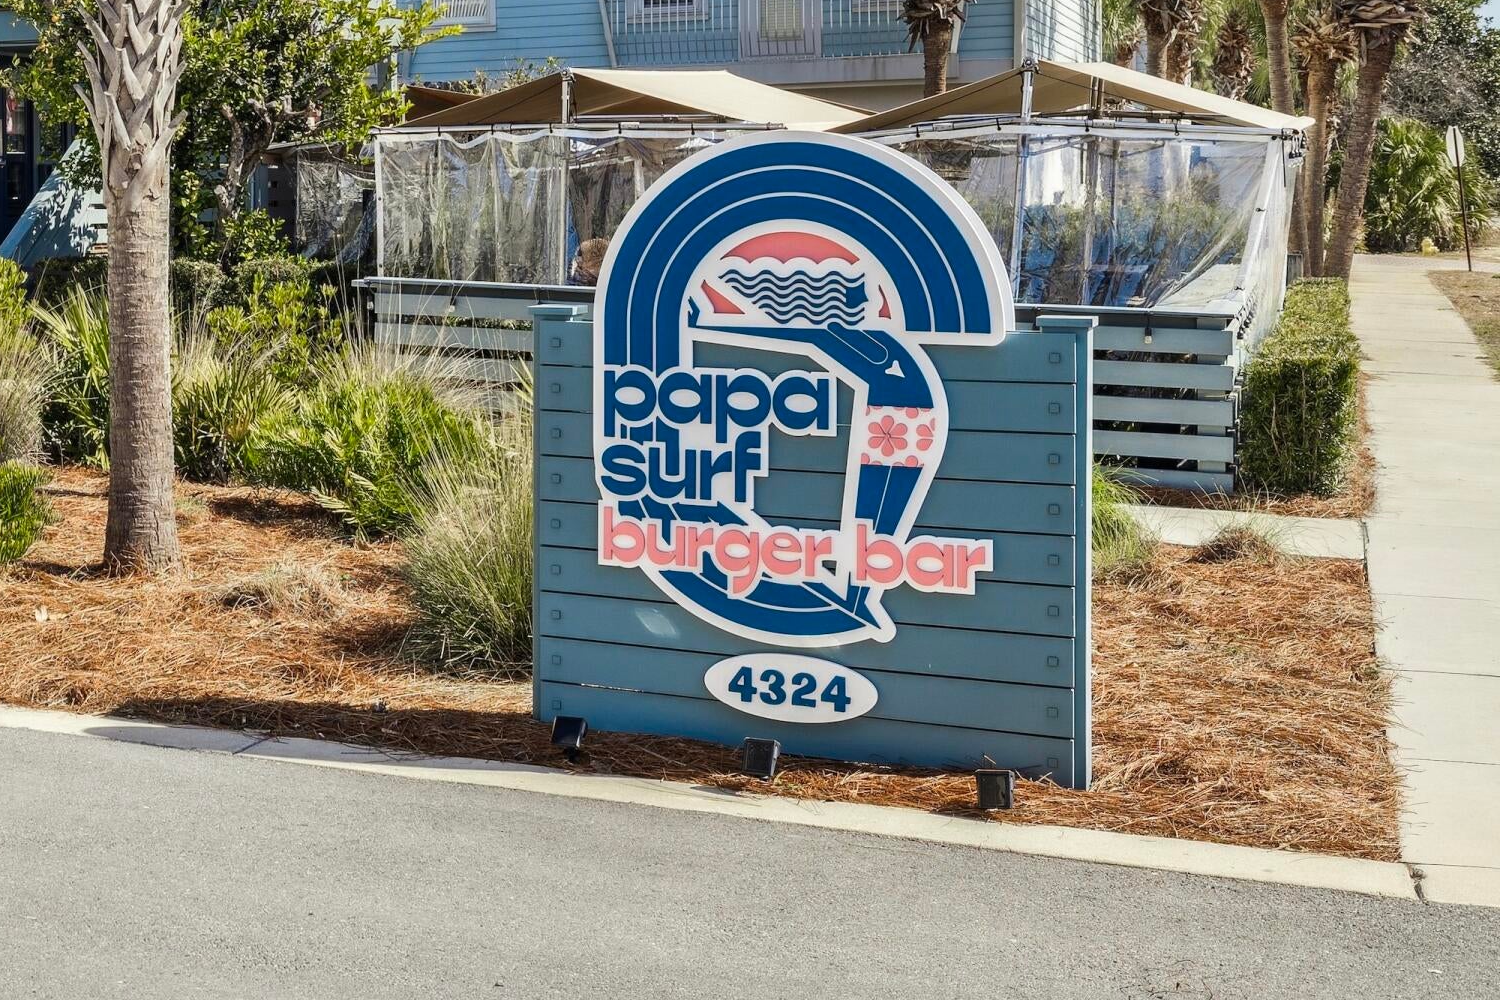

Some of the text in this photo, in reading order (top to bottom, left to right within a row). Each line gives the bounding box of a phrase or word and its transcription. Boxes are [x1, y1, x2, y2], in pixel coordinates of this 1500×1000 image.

[603, 369, 830, 443] papa
[600, 430, 762, 502] surf
[602, 505, 987, 594] burger bar
[728, 665, 852, 712] 4324
